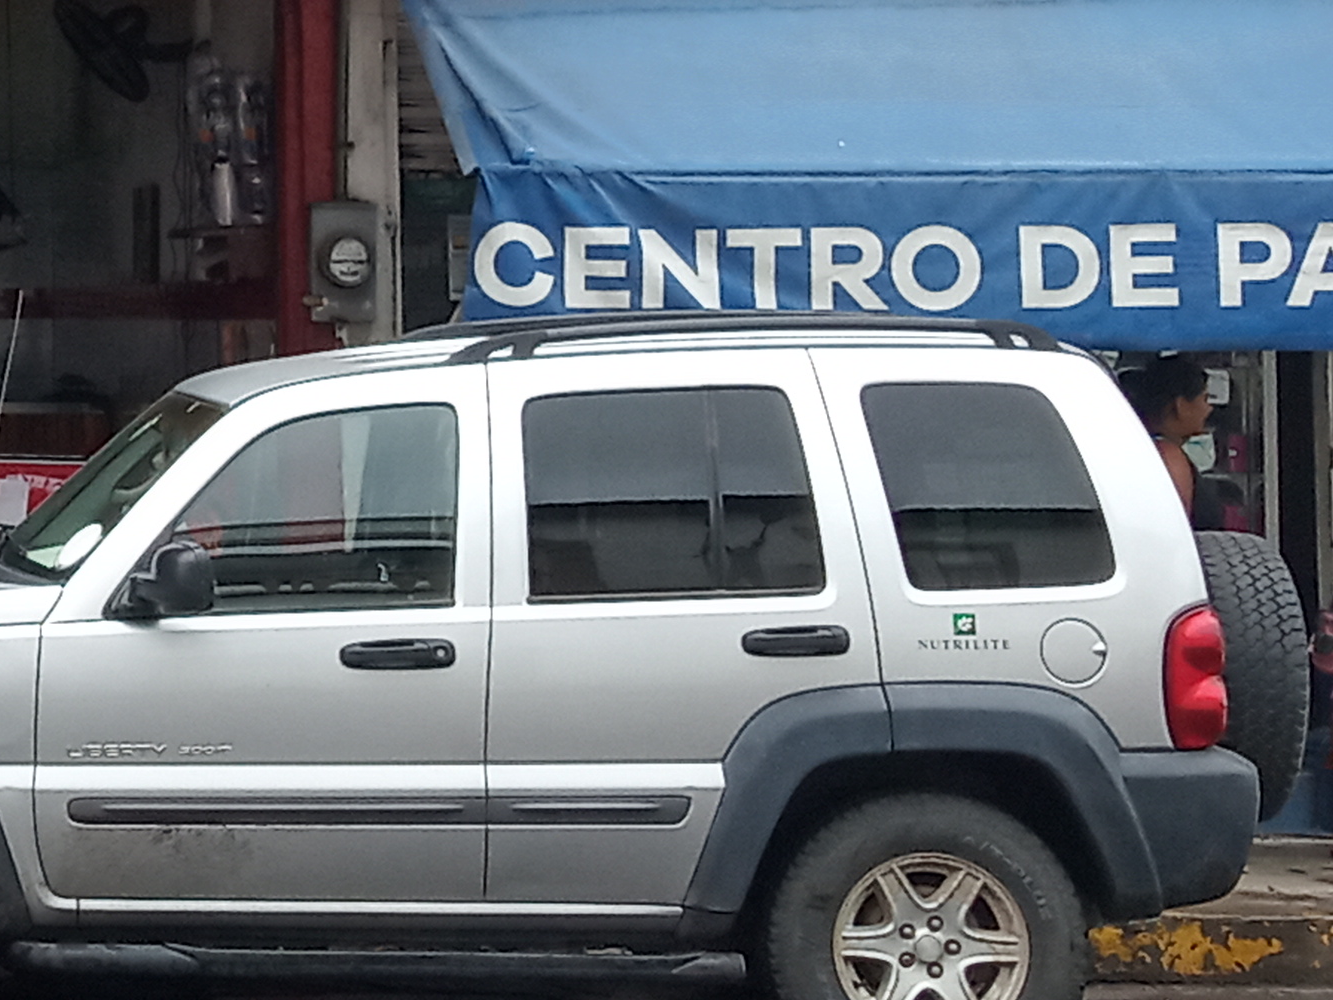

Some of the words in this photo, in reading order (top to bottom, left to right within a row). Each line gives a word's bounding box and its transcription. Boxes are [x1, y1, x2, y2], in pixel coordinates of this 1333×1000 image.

[473, 221, 981, 310] CENTRO
[1019, 223, 1180, 308] DE
[917, 638, 1013, 651] NUTRILITE
